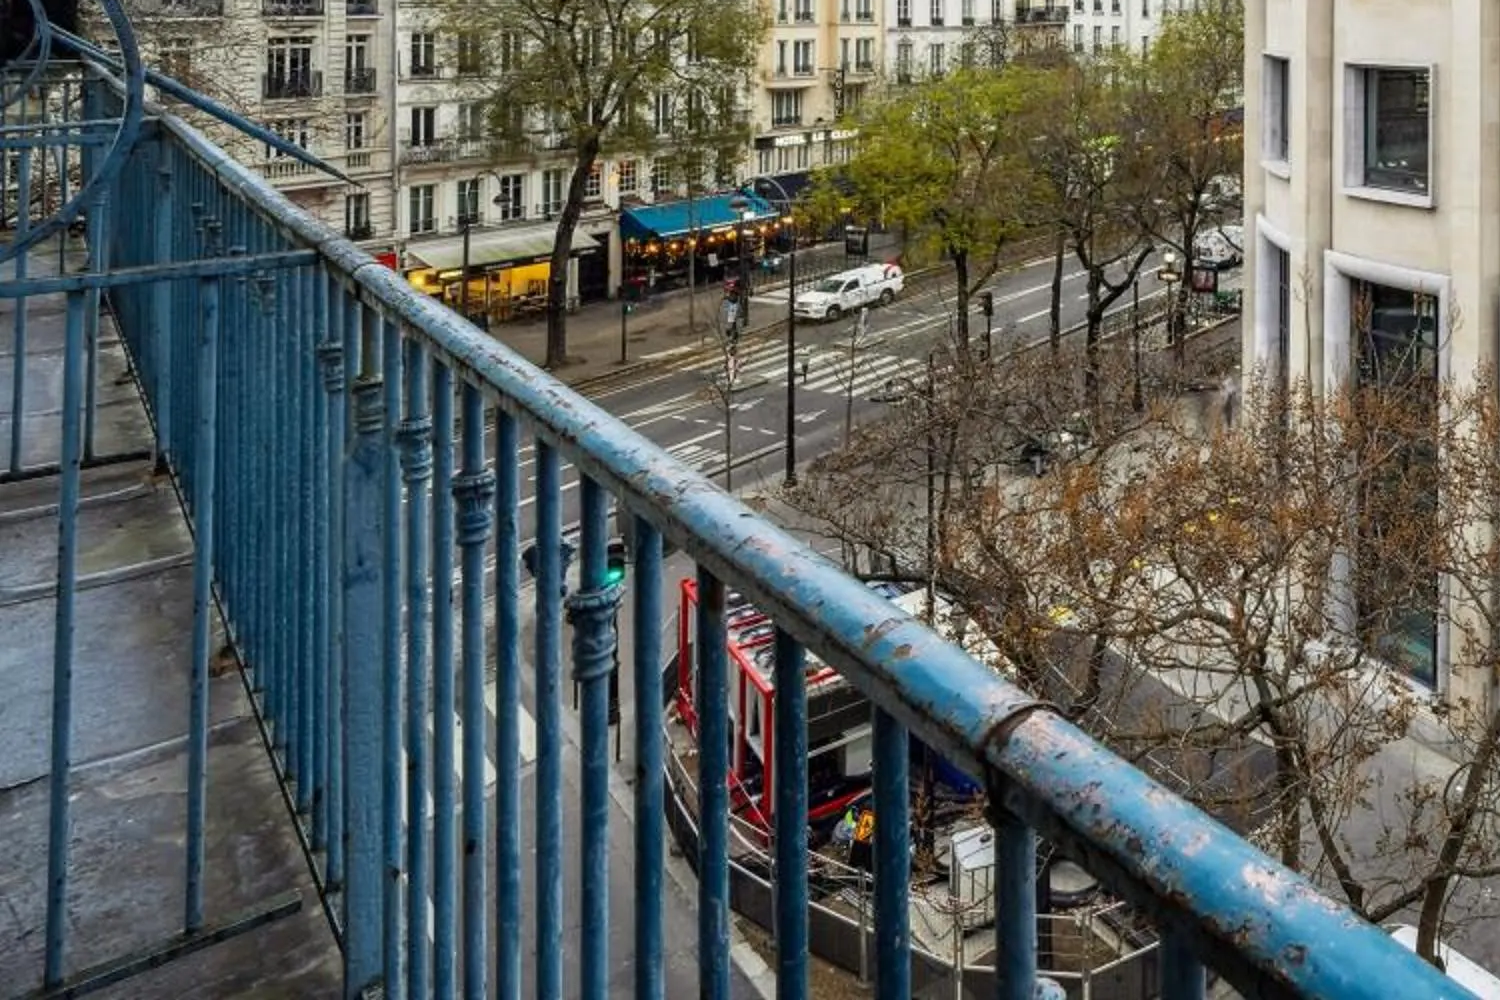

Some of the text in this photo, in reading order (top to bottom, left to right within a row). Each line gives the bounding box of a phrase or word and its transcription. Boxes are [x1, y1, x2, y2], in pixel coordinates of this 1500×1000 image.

[835, 72, 843, 117] HOTEL
[775, 134, 806, 147] HOTEL
[812, 131, 825, 143] LE
